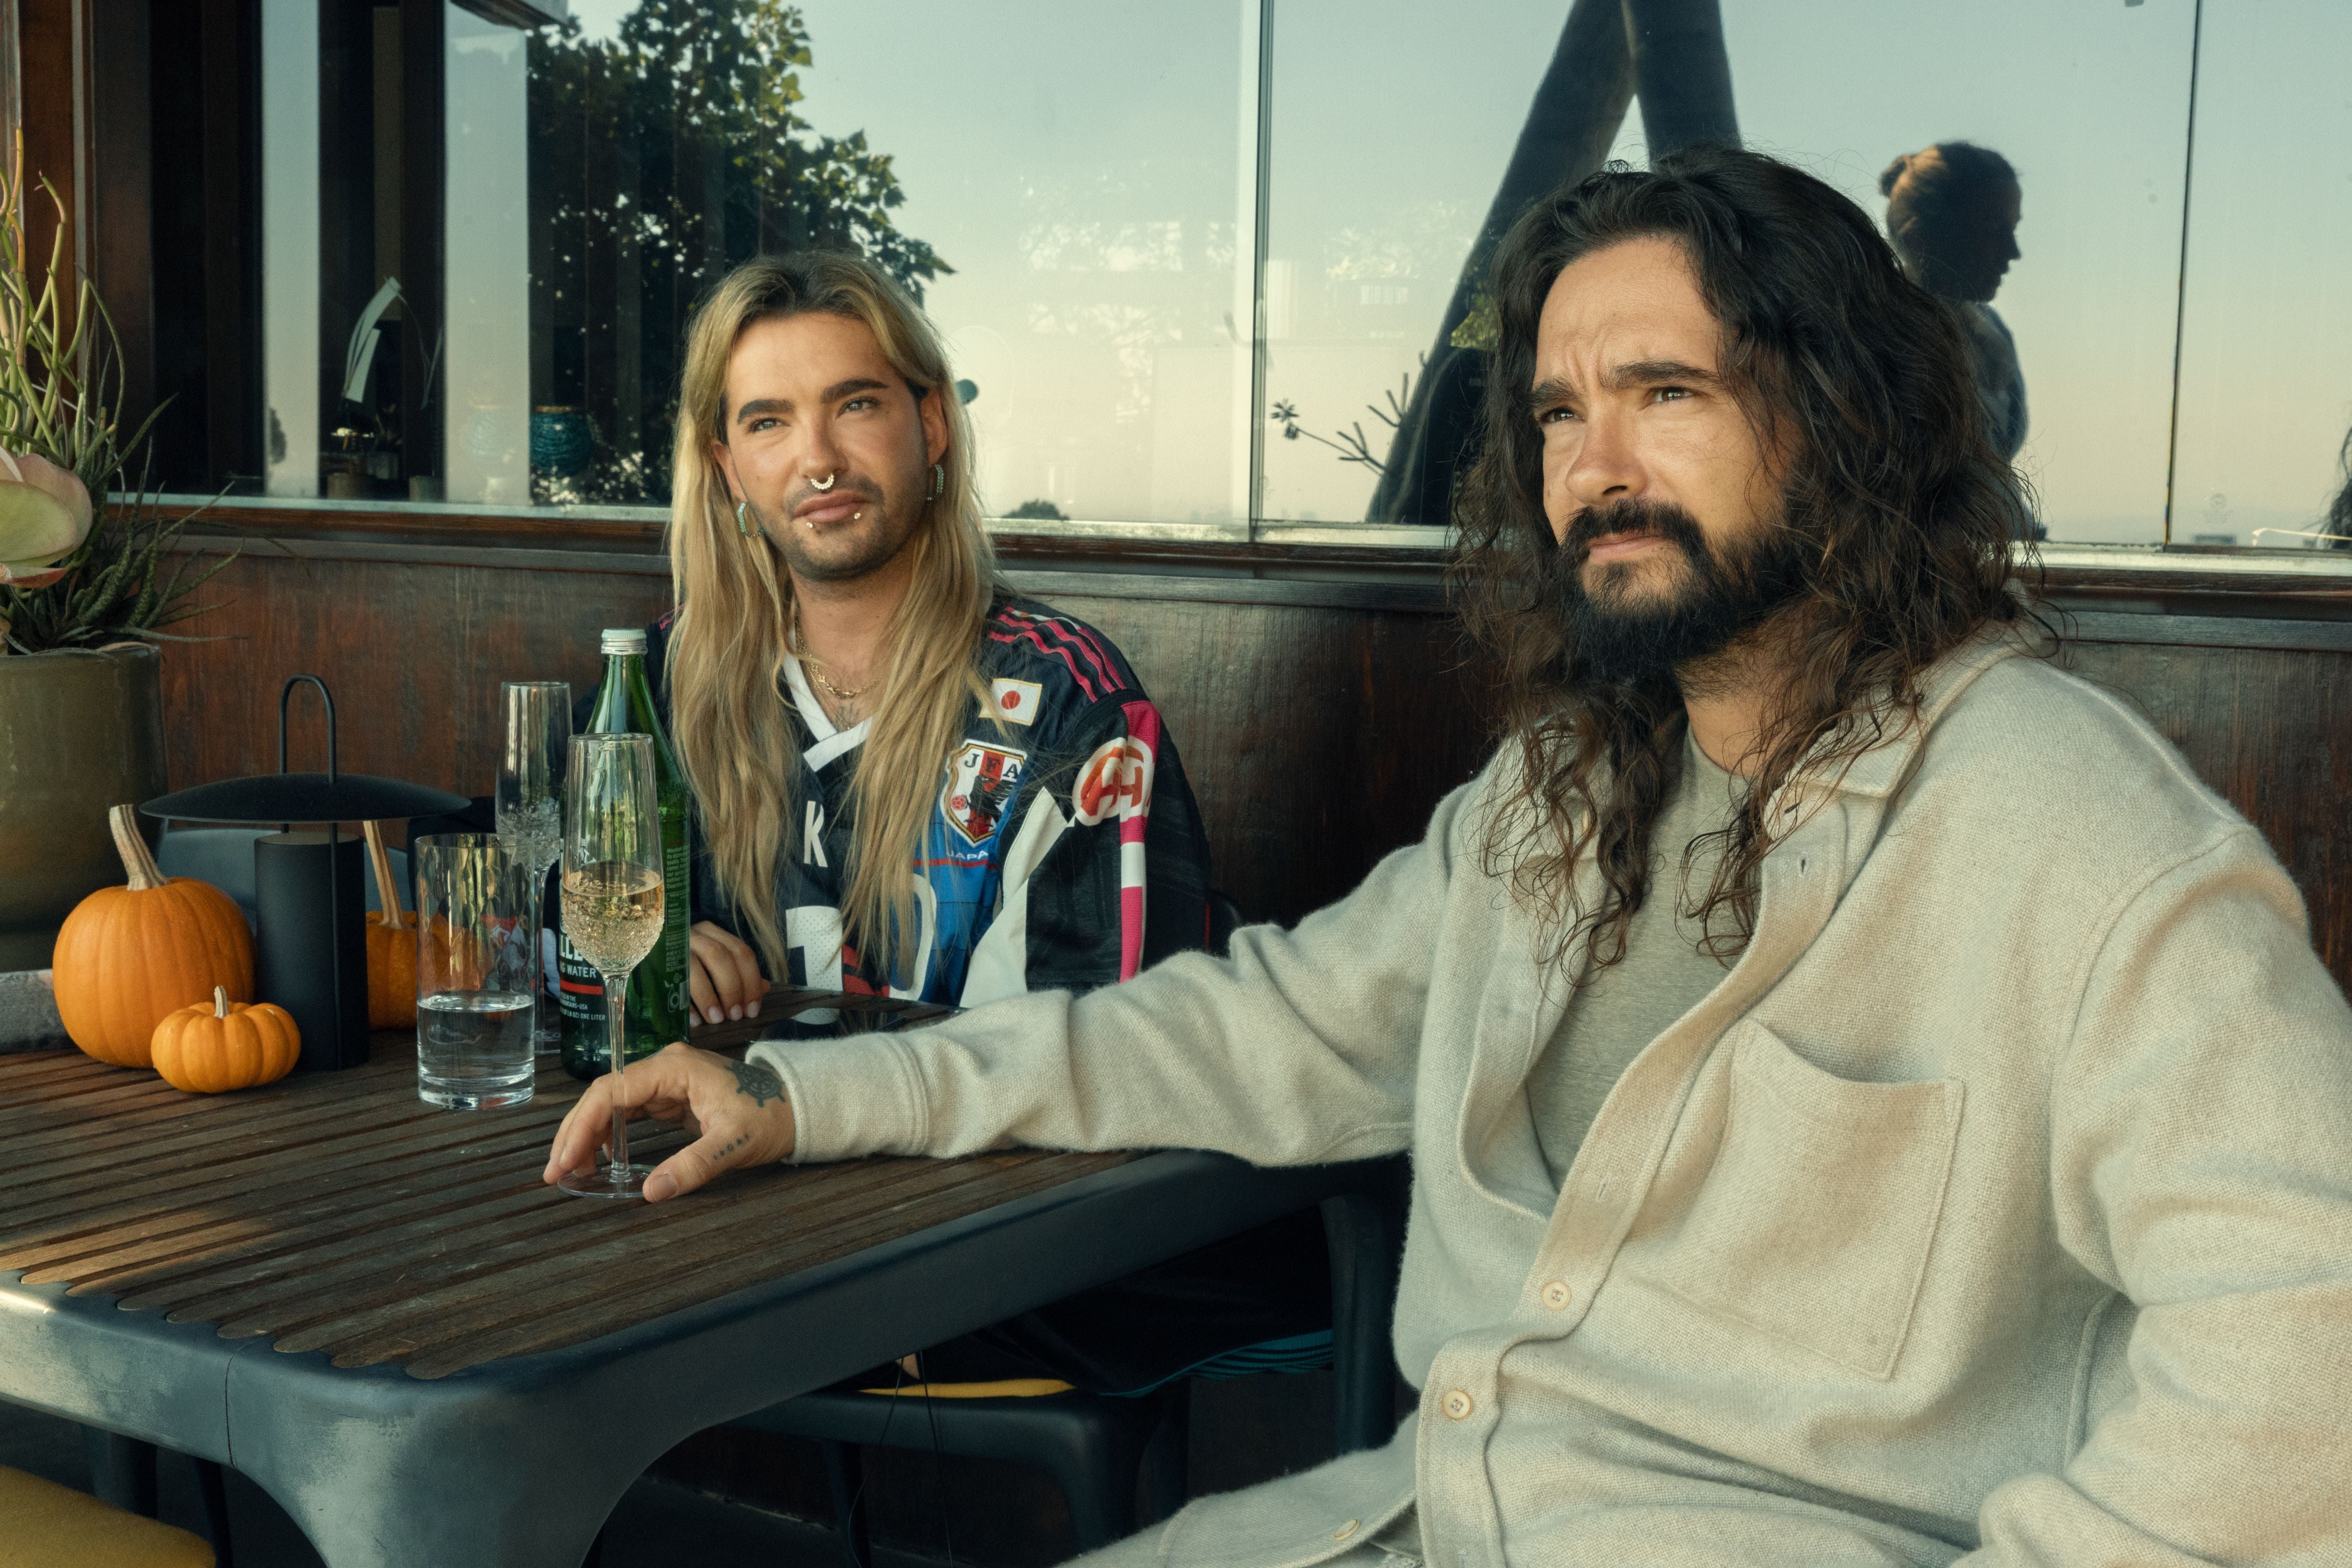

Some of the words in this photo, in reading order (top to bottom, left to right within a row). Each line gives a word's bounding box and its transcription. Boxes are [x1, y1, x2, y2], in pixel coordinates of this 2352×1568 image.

[964, 753, 1019, 779] JFA
[946, 850, 988, 859] JAPA
[567, 964, 597, 978] WATER
